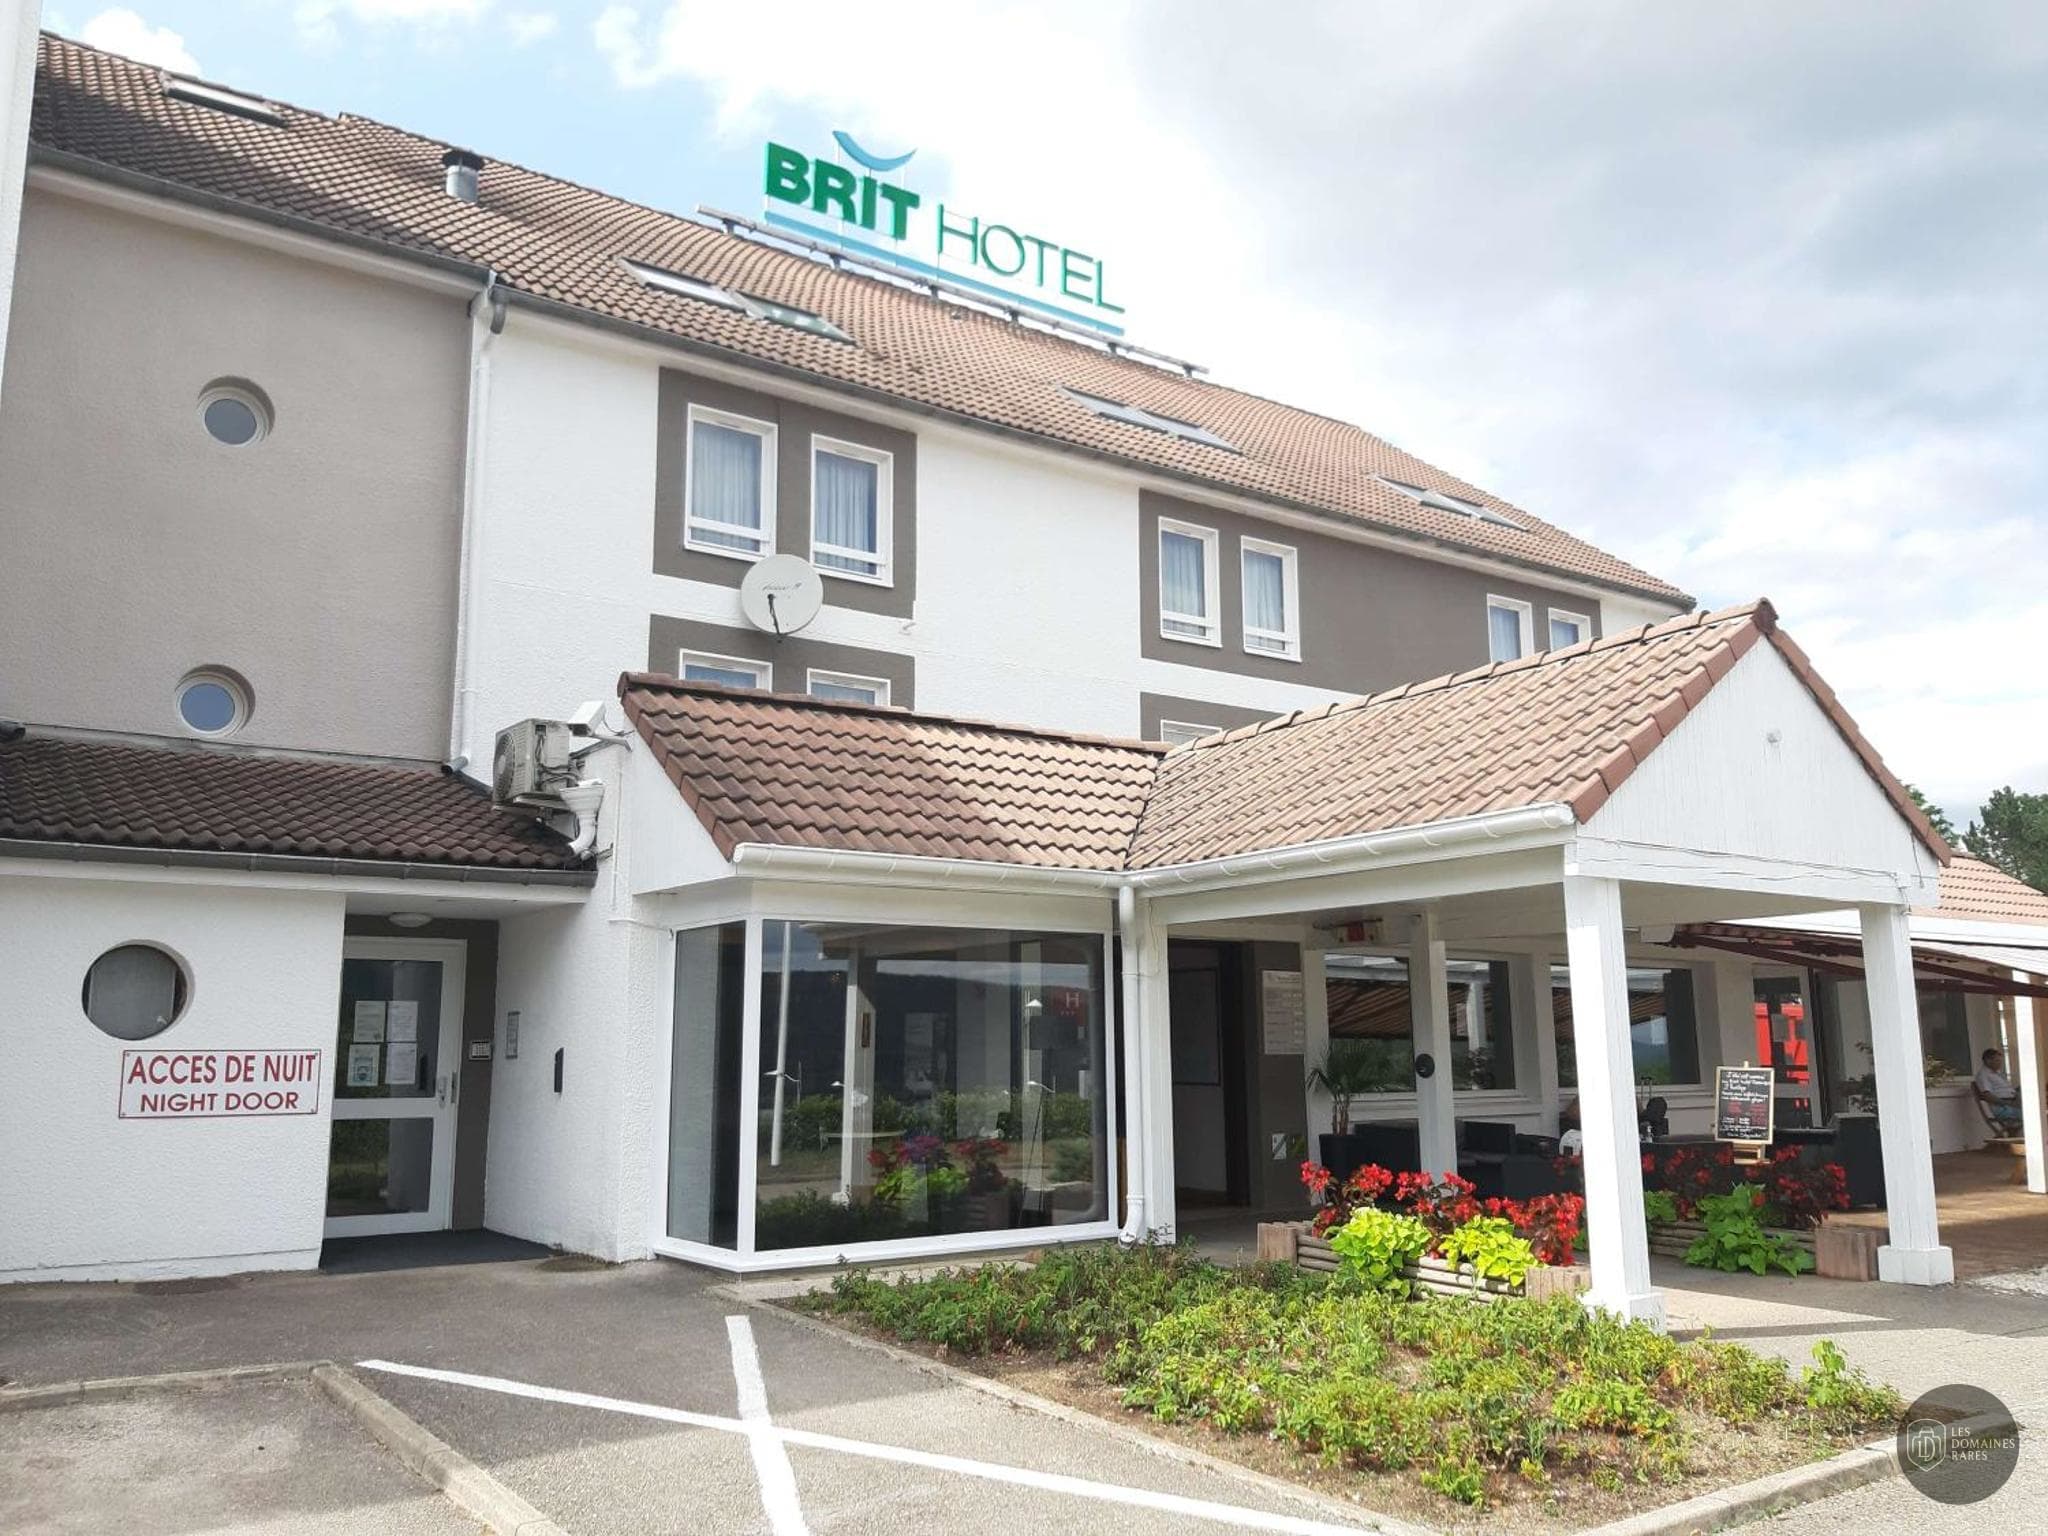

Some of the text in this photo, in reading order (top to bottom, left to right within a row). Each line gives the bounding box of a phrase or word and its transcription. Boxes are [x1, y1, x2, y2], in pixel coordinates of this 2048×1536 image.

[765, 141, 1125, 313] BRIT HOTEL
[127, 1054, 217, 1084] ACCES
[224, 1054, 256, 1083] DE
[263, 1054, 317, 1082] NUIT
[140, 1091, 299, 1112] NIGHT DOOR
